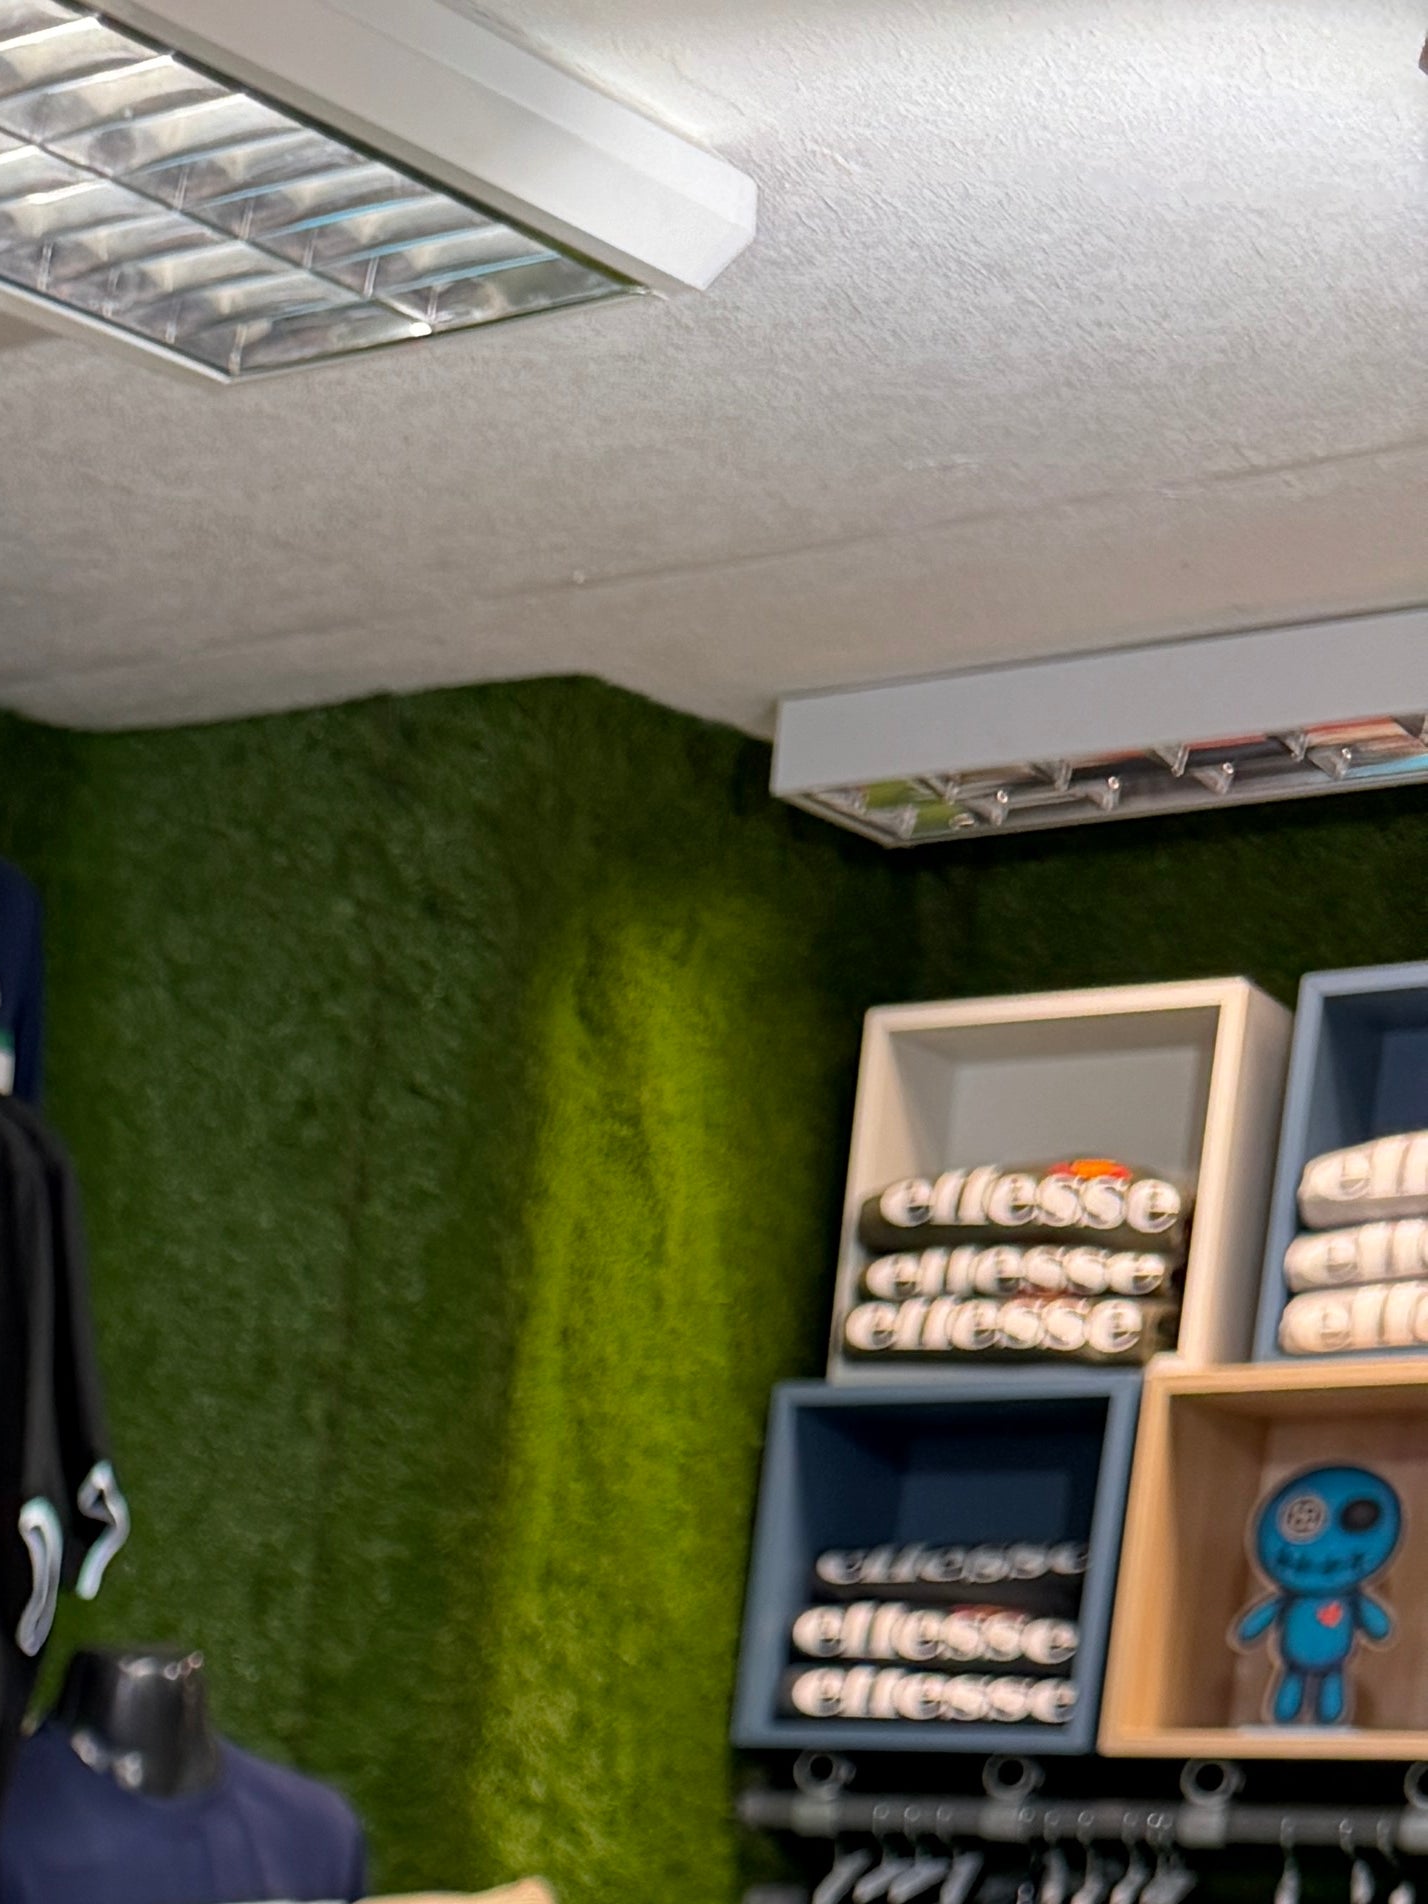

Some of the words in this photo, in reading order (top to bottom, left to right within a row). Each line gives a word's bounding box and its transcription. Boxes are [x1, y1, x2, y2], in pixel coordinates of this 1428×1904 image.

[880, 1165, 1181, 1233] ellesse
[865, 1246, 1166, 1299] ellesse
[845, 1296, 1143, 1353] ellesse
[792, 1600, 1079, 1665] ellesse
[792, 1664, 1078, 1724] ellesse
